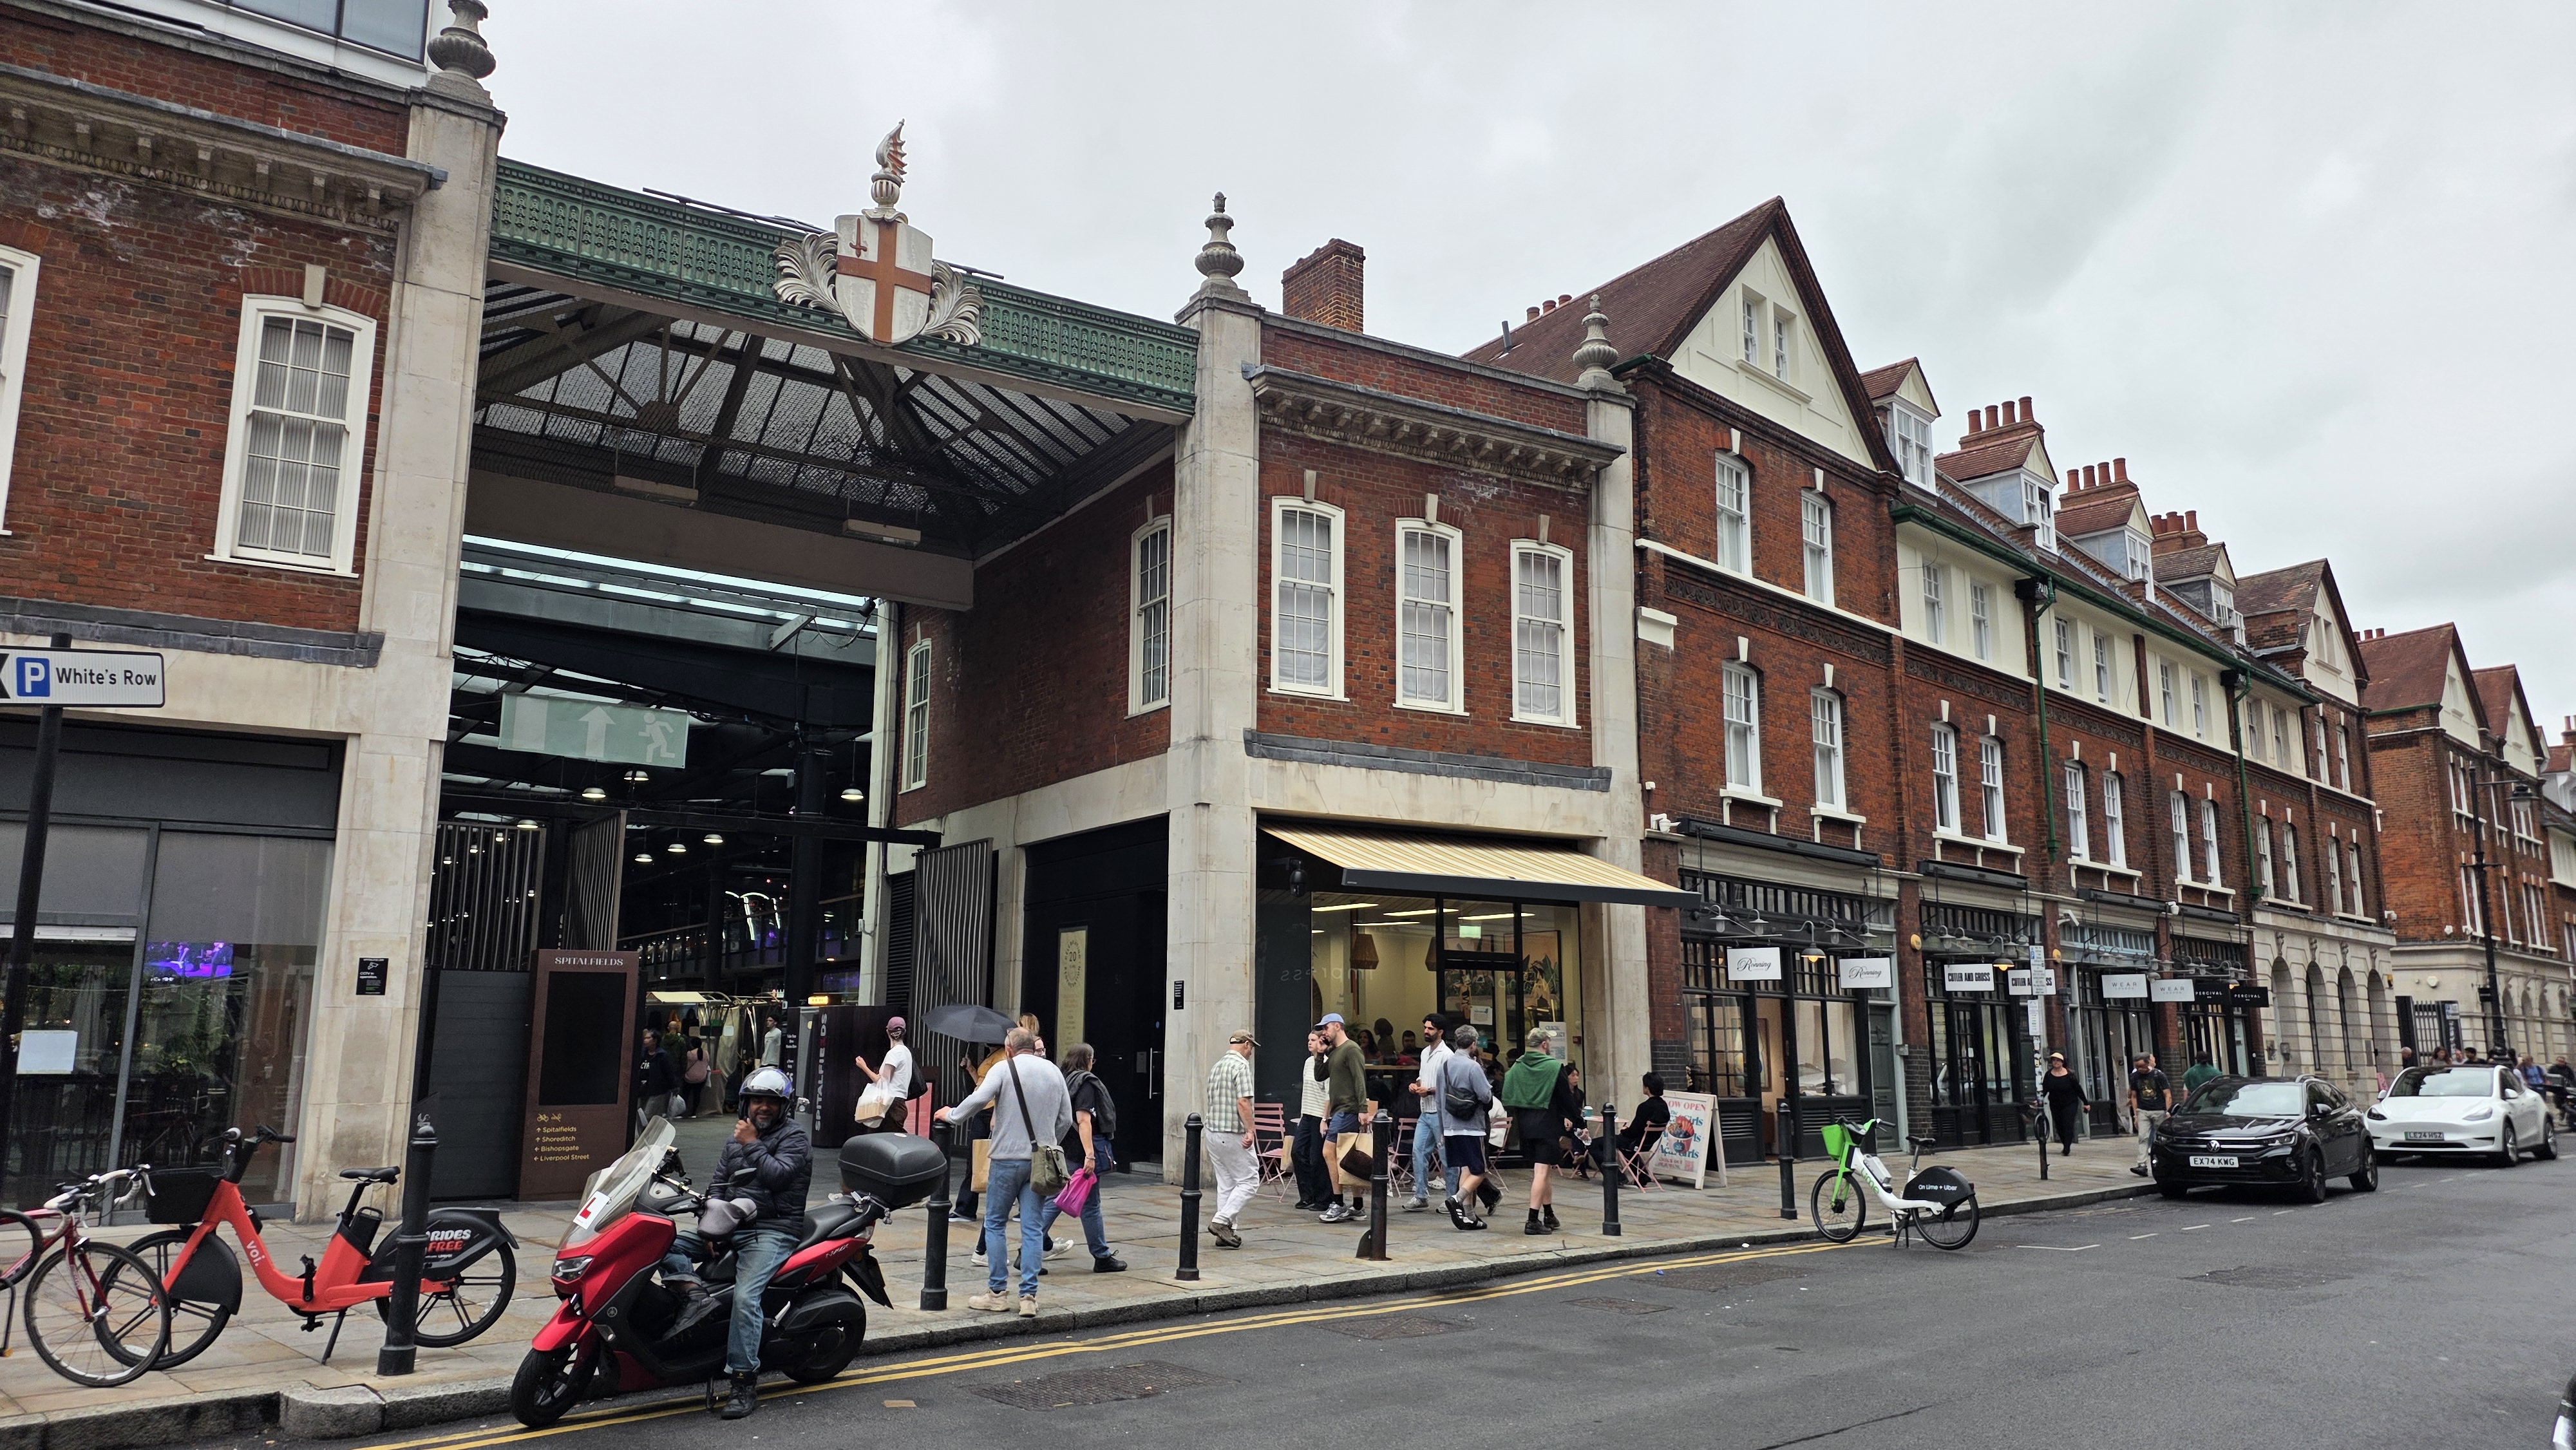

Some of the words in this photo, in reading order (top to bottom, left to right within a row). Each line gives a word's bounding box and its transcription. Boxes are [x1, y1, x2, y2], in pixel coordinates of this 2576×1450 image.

[24, 662, 45, 693] P
[55, 667, 117, 684] White's
[124, 670, 156, 685] Row
[1069, 951, 1076, 961] 20
[555, 957, 623, 966] SPITALFIELDS
[1947, 973, 1963, 982] CUTLER
[1965, 973, 1973, 981] AND
[1975, 972, 1990, 981] GROSS
[2012, 978, 2026, 986] CUTLER
[1683, 1102, 1706, 1111] OPEN
[1861, 1168, 1880, 1194] Lime
[580, 1197, 596, 1219] L
[427, 1241, 464, 1252] FREE
[246, 1240, 265, 1266] voi.
